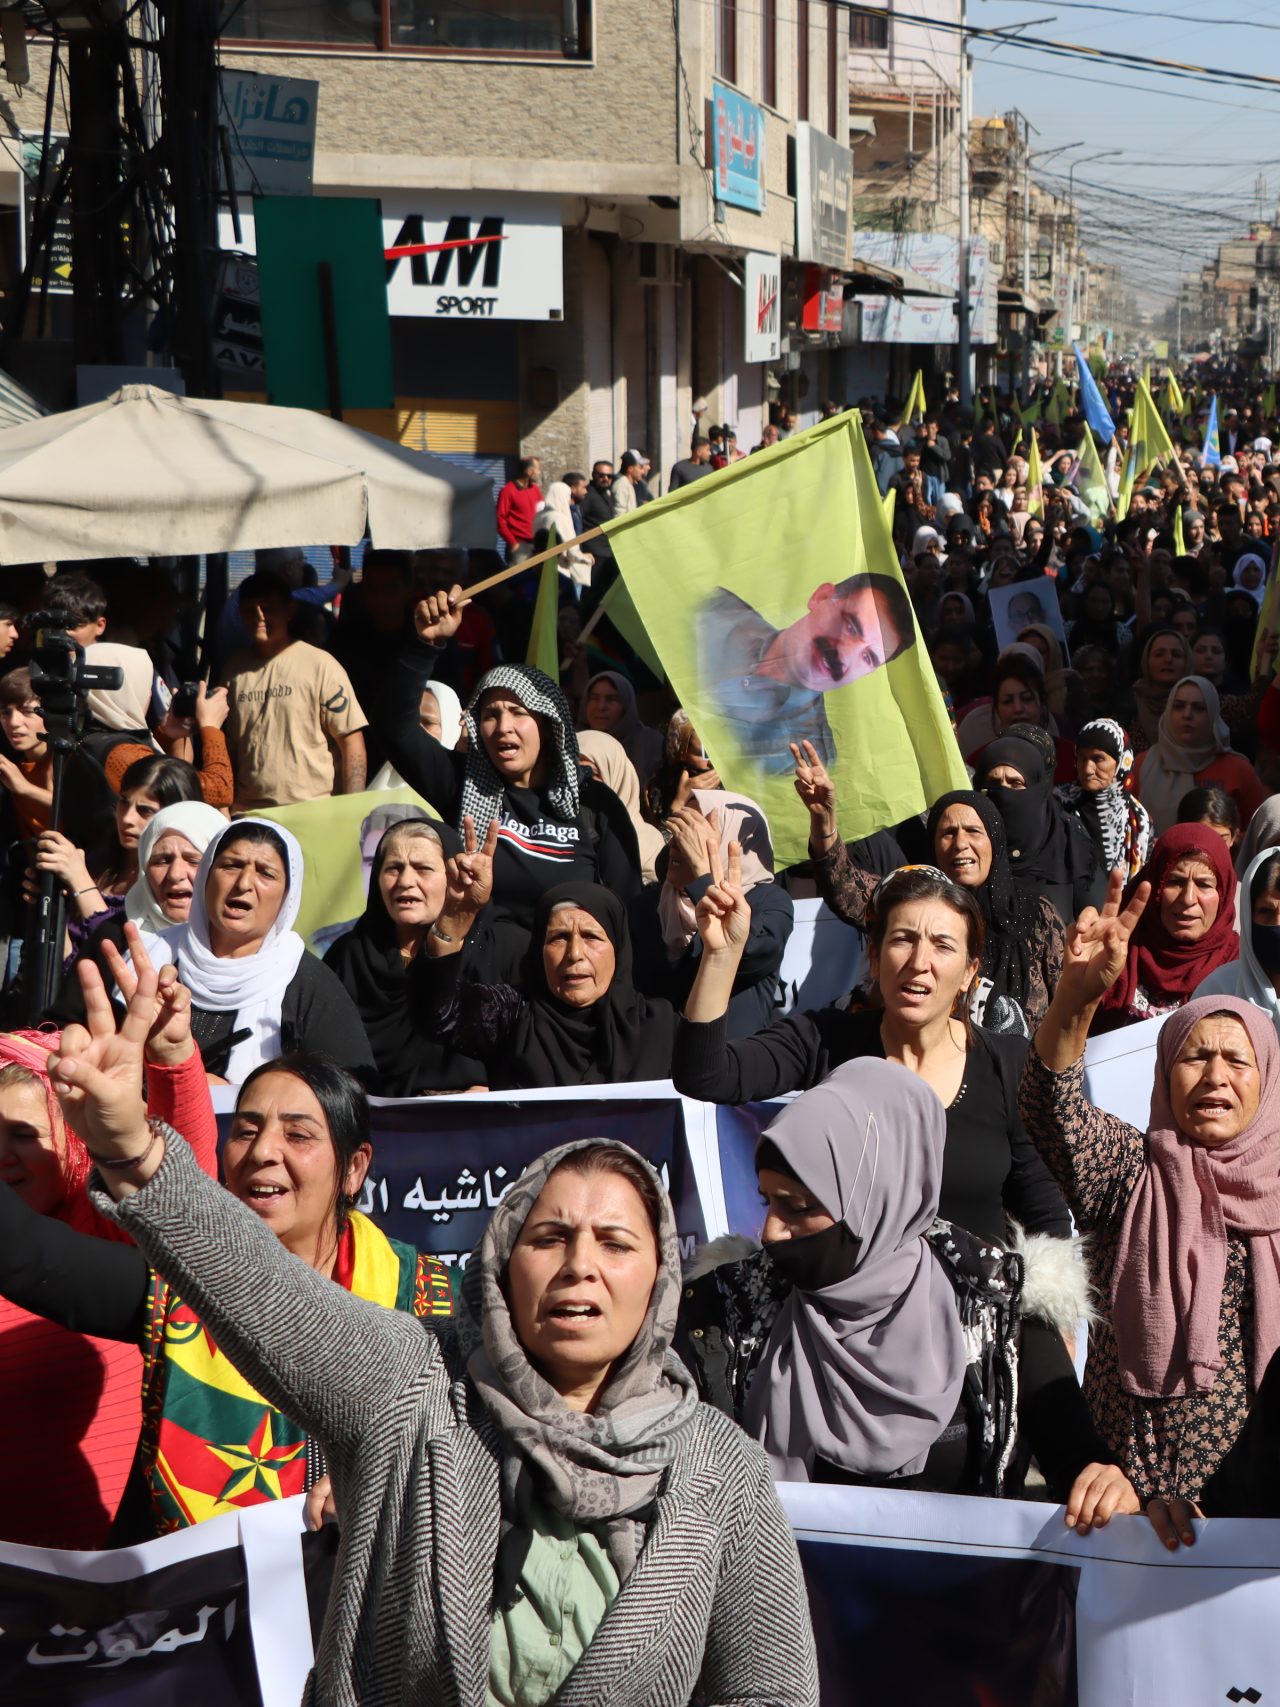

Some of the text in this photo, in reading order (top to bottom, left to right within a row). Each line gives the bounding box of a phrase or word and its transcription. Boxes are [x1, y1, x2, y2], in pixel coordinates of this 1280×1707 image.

[388, 214, 506, 288] AM
[436, 296, 499, 316] SPORT
[499, 811, 580, 843] lenciaga
[402, 1165, 512, 1222] فاشيه
[26, 1597, 237, 1669] الموت
